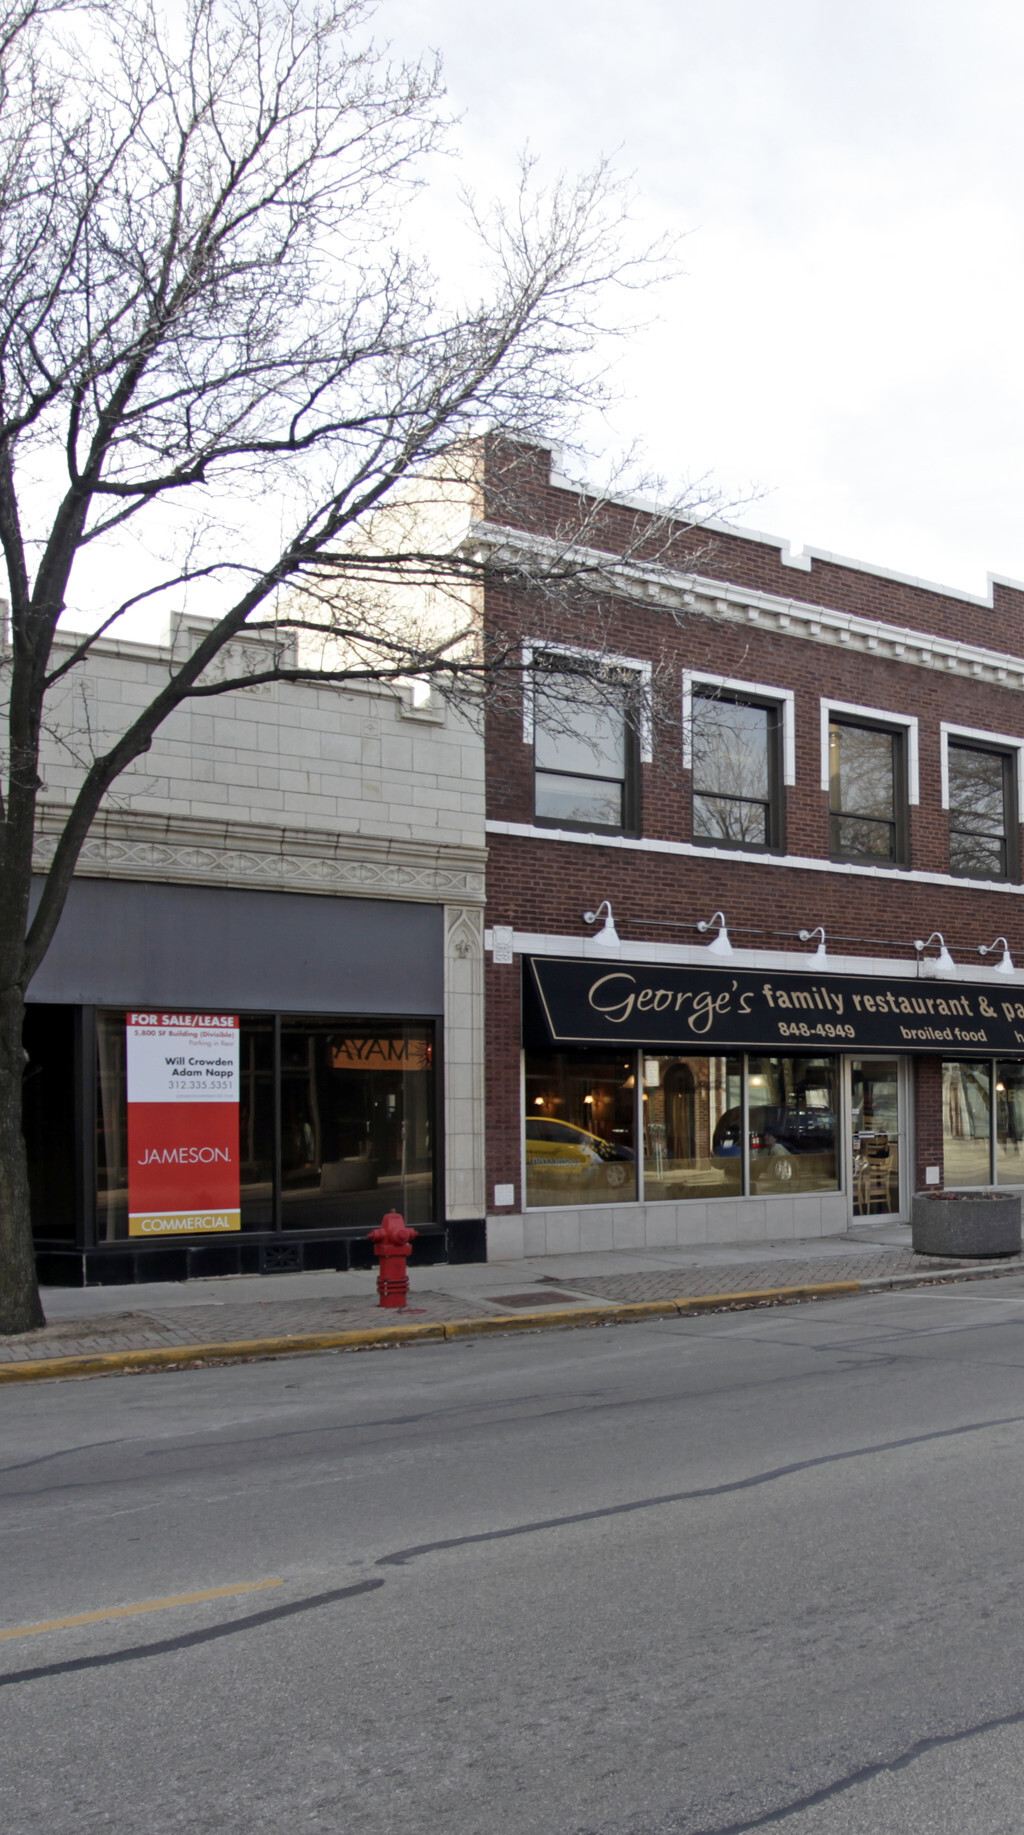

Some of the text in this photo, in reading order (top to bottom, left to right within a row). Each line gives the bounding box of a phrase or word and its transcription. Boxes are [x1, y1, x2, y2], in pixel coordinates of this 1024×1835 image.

[588, 973, 754, 1033] George's
[763, 984, 843, 1015] family
[852, 992, 973, 1016] restaurant
[979, 996, 998, 1018] &
[131, 1014, 234, 1027] FOR SALE/LEASE
[169, 1031, 198, 1039] Building
[778, 1022, 855, 1038] 848-4949
[900, 1026, 988, 1042] broiled food
[189, 1040, 212, 1048] Parking
[165, 1057, 234, 1067] Will Crowden
[172, 1068, 234, 1079] Adam Napp
[168, 1081, 233, 1090] 312.335.5351
[141, 1216, 230, 1231] COMMERCIAL
